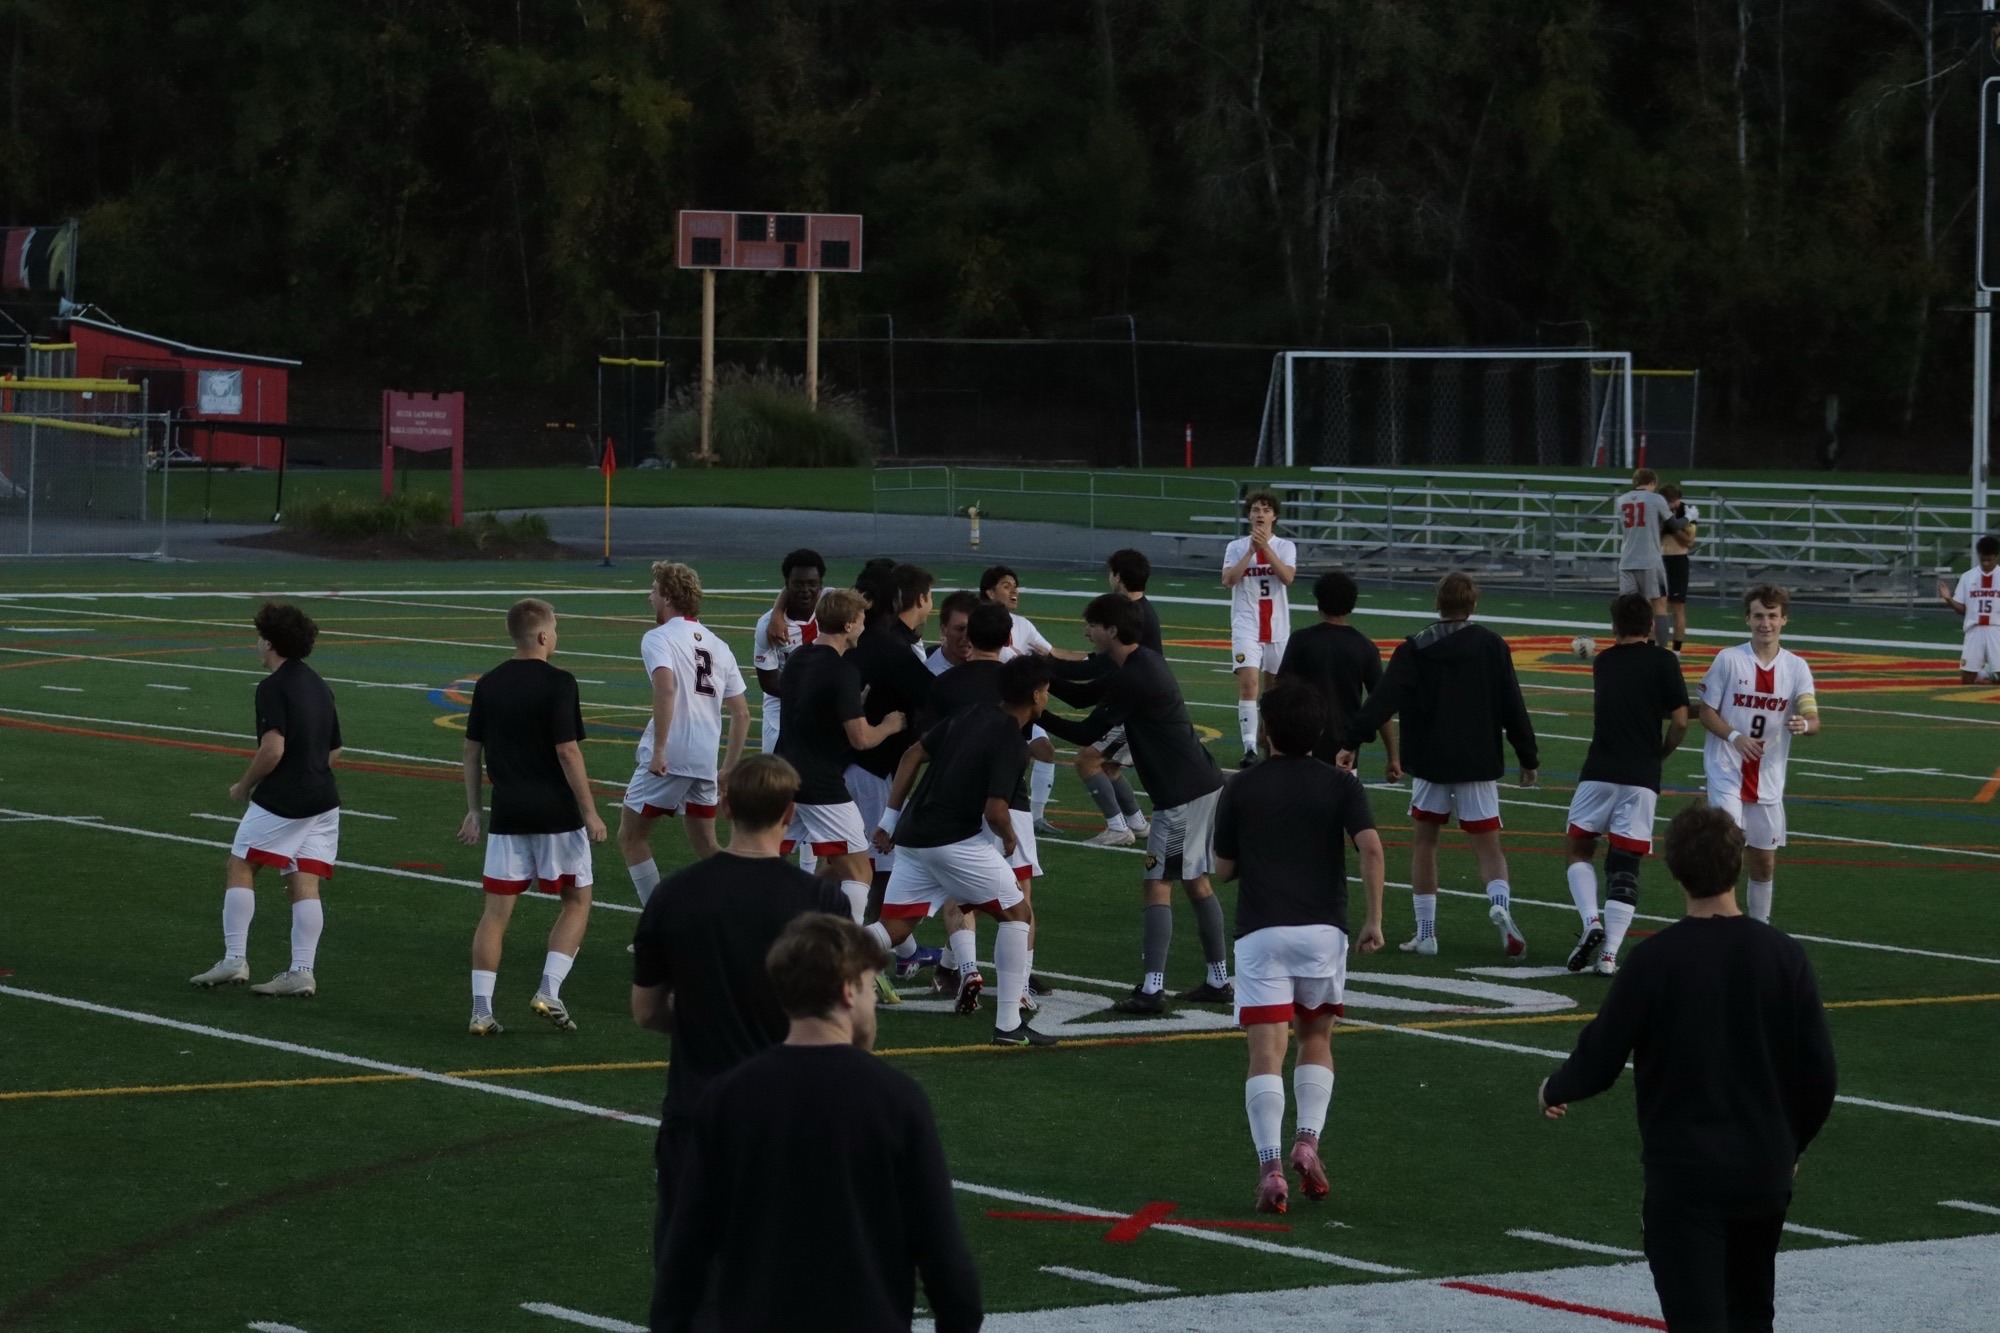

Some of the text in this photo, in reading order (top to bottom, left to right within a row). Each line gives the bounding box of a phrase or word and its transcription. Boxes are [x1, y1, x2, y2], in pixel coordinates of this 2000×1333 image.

[1621, 502, 1646, 528] 31
[1242, 567, 1275, 577] KING
[1260, 580, 1270, 597] 5
[1978, 599, 1993, 614] 15
[694, 646, 716, 697] 2
[1733, 693, 1789, 712] KING'S
[1750, 715, 1767, 739] 9
